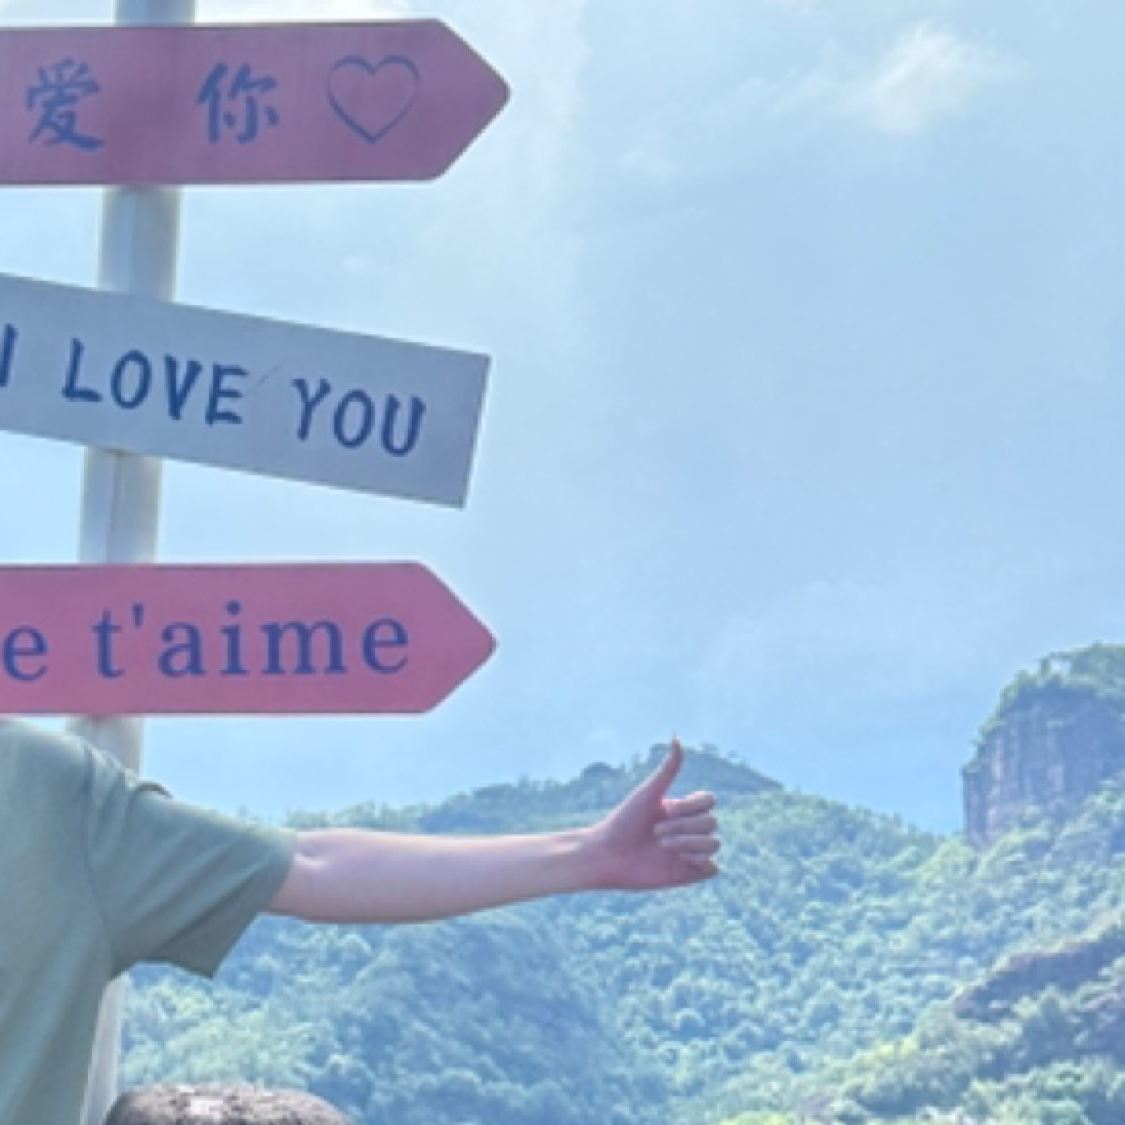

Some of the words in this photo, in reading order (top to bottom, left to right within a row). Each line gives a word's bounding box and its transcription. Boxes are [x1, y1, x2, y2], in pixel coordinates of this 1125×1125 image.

[61, 338, 248, 426] LOVE
[292, 376, 427, 458] YOU
[91, 600, 411, 679] t'aime
